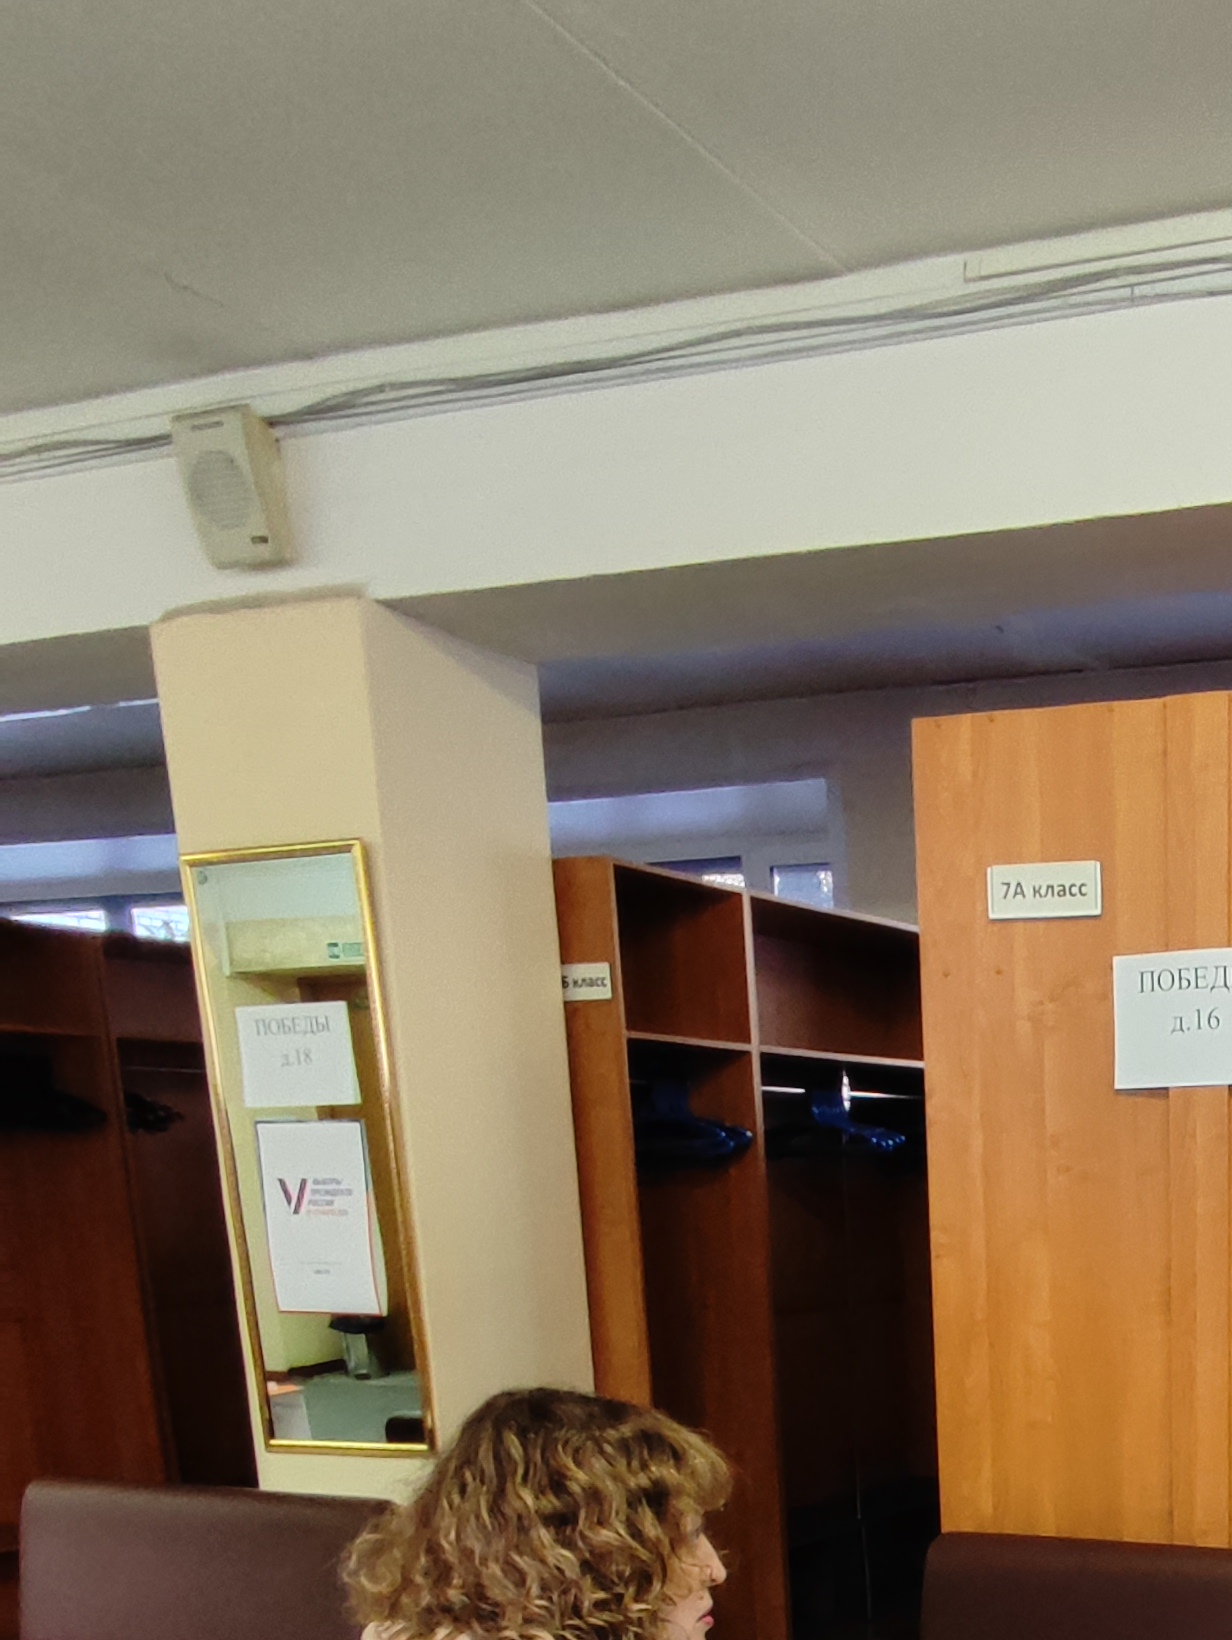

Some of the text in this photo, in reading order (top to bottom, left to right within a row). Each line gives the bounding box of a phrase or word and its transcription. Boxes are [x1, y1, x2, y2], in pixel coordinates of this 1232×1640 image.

[1001, 881, 1088, 900] 7А класс
[572, 976, 607, 989] класс
[254, 1014, 331, 1037] ПОБЕДЫ
[1170, 1007, 1221, 1035] д.16
